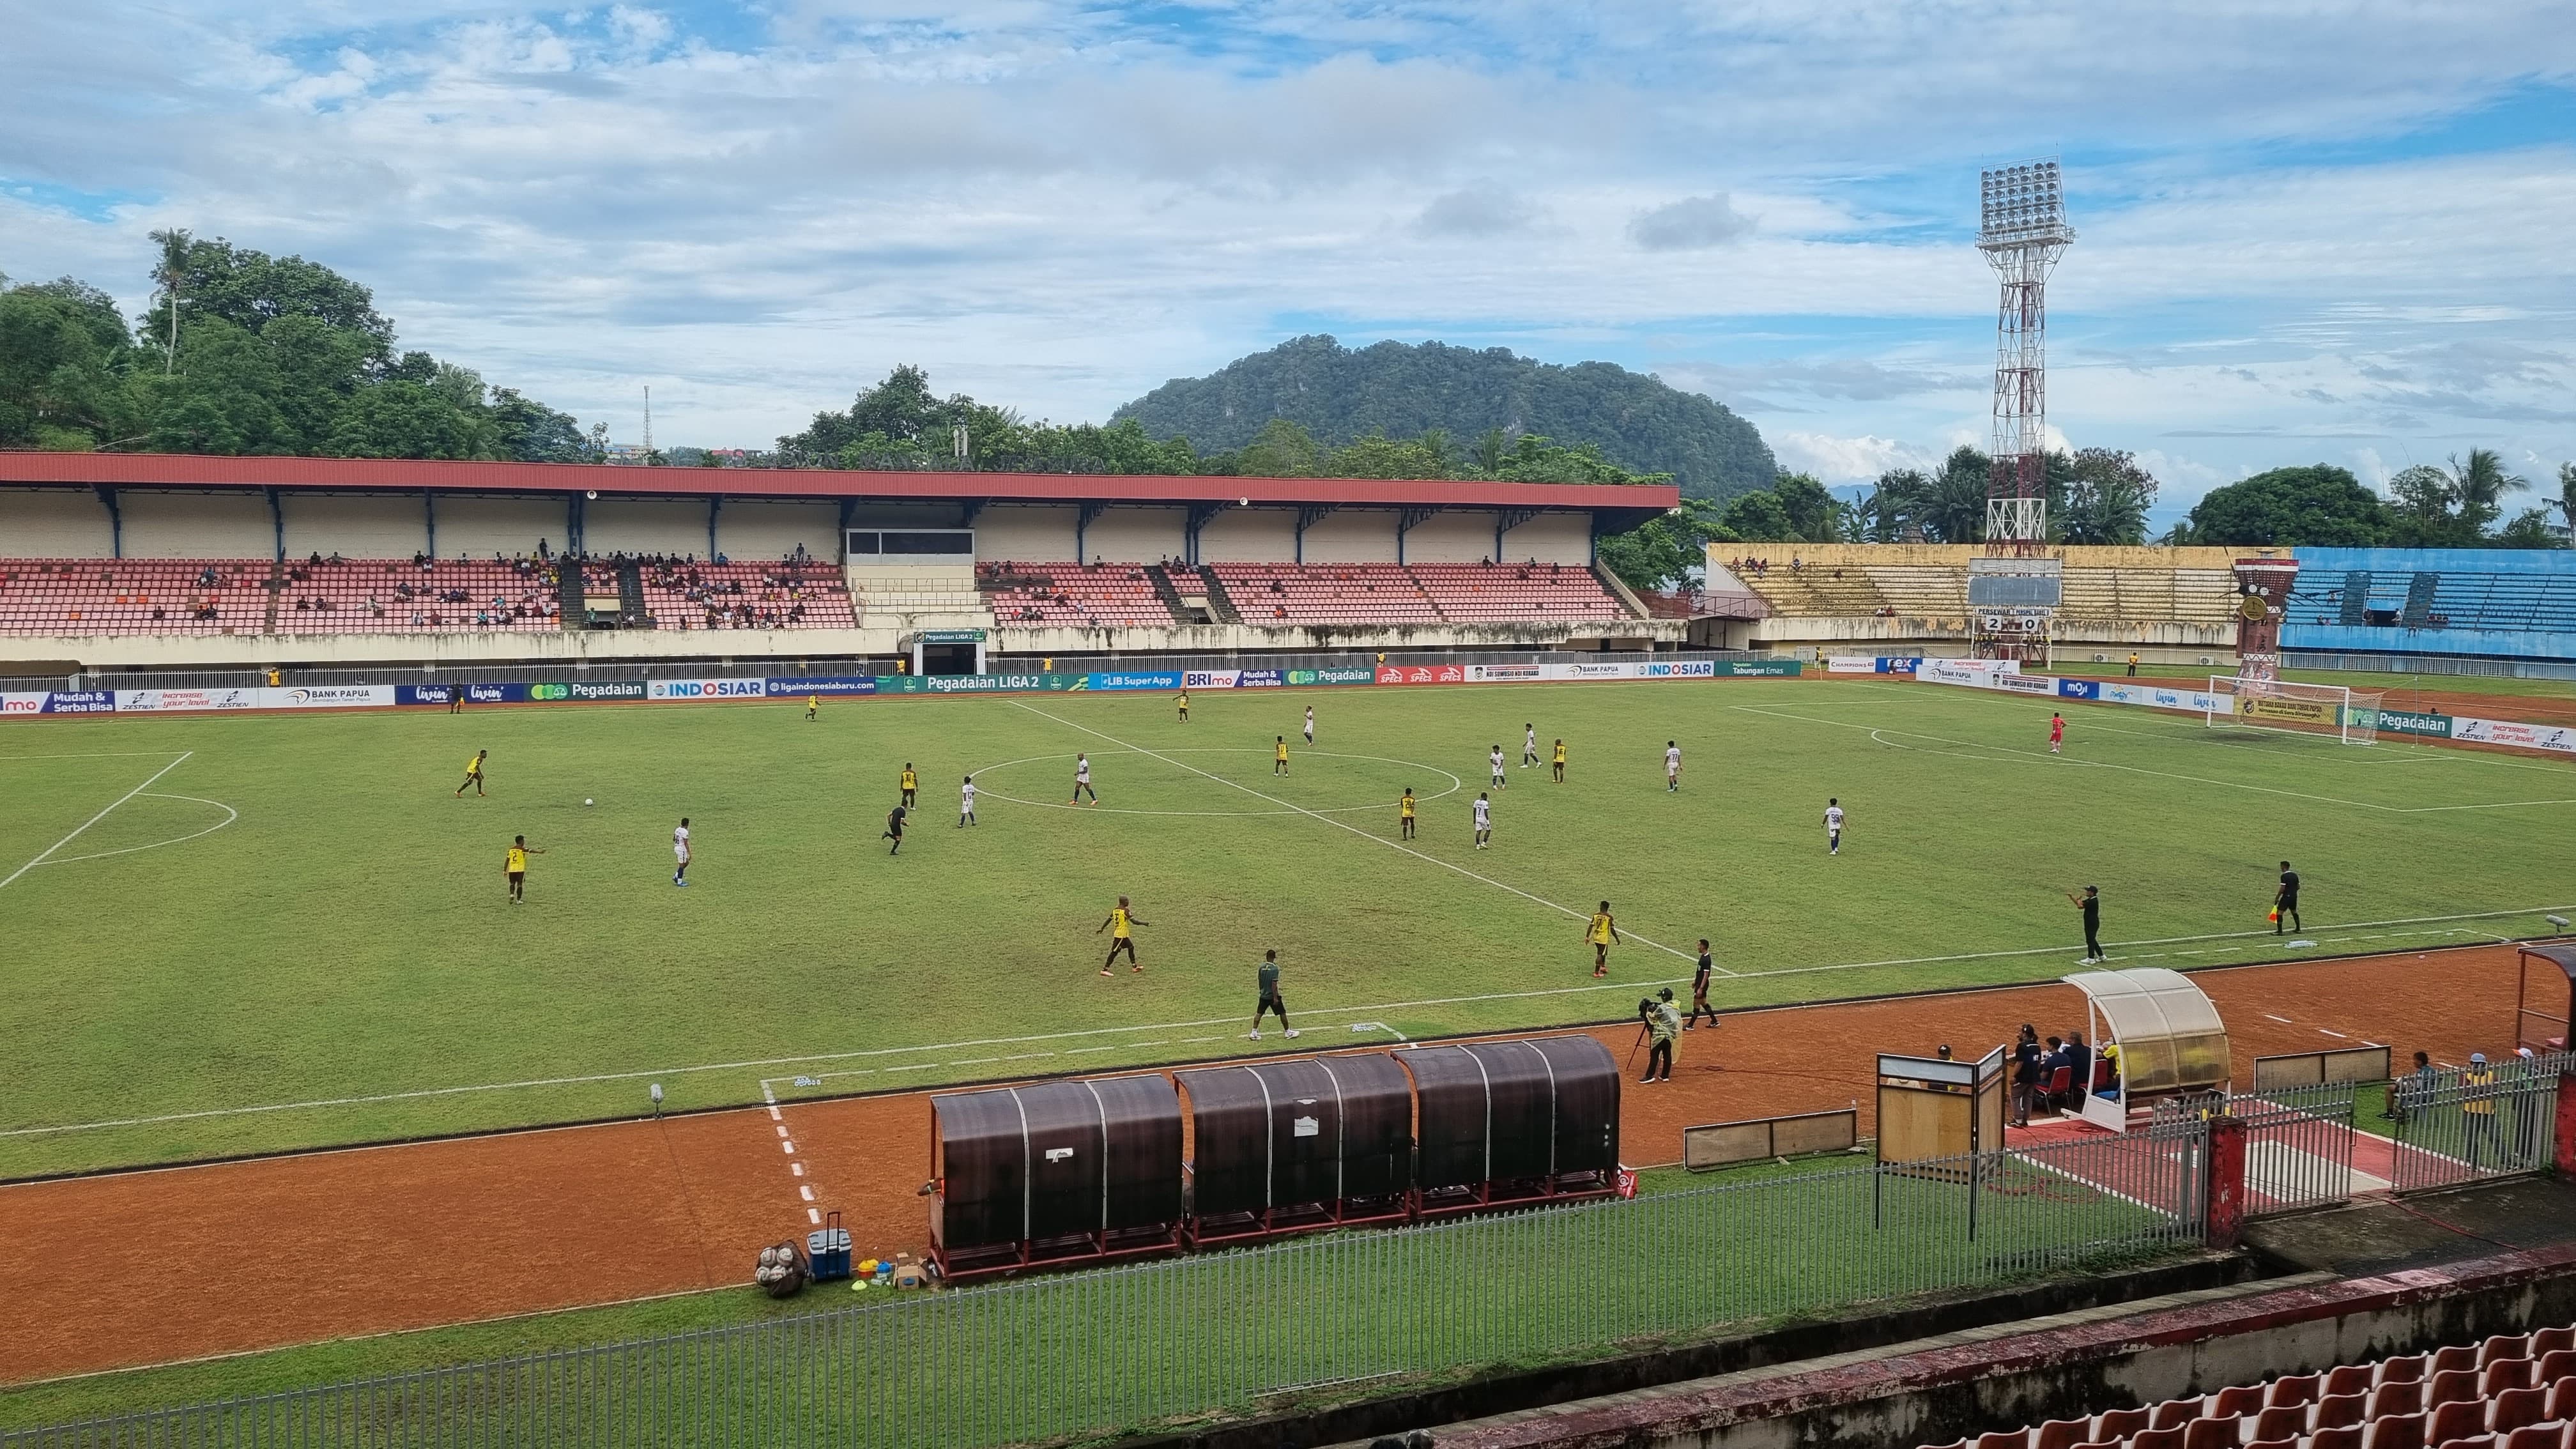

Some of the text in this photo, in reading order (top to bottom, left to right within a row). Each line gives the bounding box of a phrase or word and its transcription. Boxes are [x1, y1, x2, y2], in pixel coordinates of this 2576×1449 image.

[1989, 618, 1998, 628] 2
[2025, 619, 2035, 629] 0
[1648, 664, 1711, 676] INDOSIAR
[1733, 667, 1765, 676] Tabungan
[1107, 677, 1123, 686] LIB
[1187, 673, 1232, 686] BRImo
[1318, 670, 1370, 683] Pegadaian
[669, 682, 762, 696] INDOSIAR
[781, 682, 875, 692] ligaindonesiabaru.com
[928, 676, 1039, 692] Pegadaian LIGA 2
[572, 684, 641, 698] Pegadaian
[54, 692, 105, 702] Mudah &
[54, 702, 113, 712] Serba Bisa
[2379, 712, 2446, 732] Pegadaian
[2491, 733, 2536, 743] your level
[2541, 742, 2573, 750] ZESTIEN
[1477, 806, 1482, 815] 7
[512, 852, 517, 862] 2
